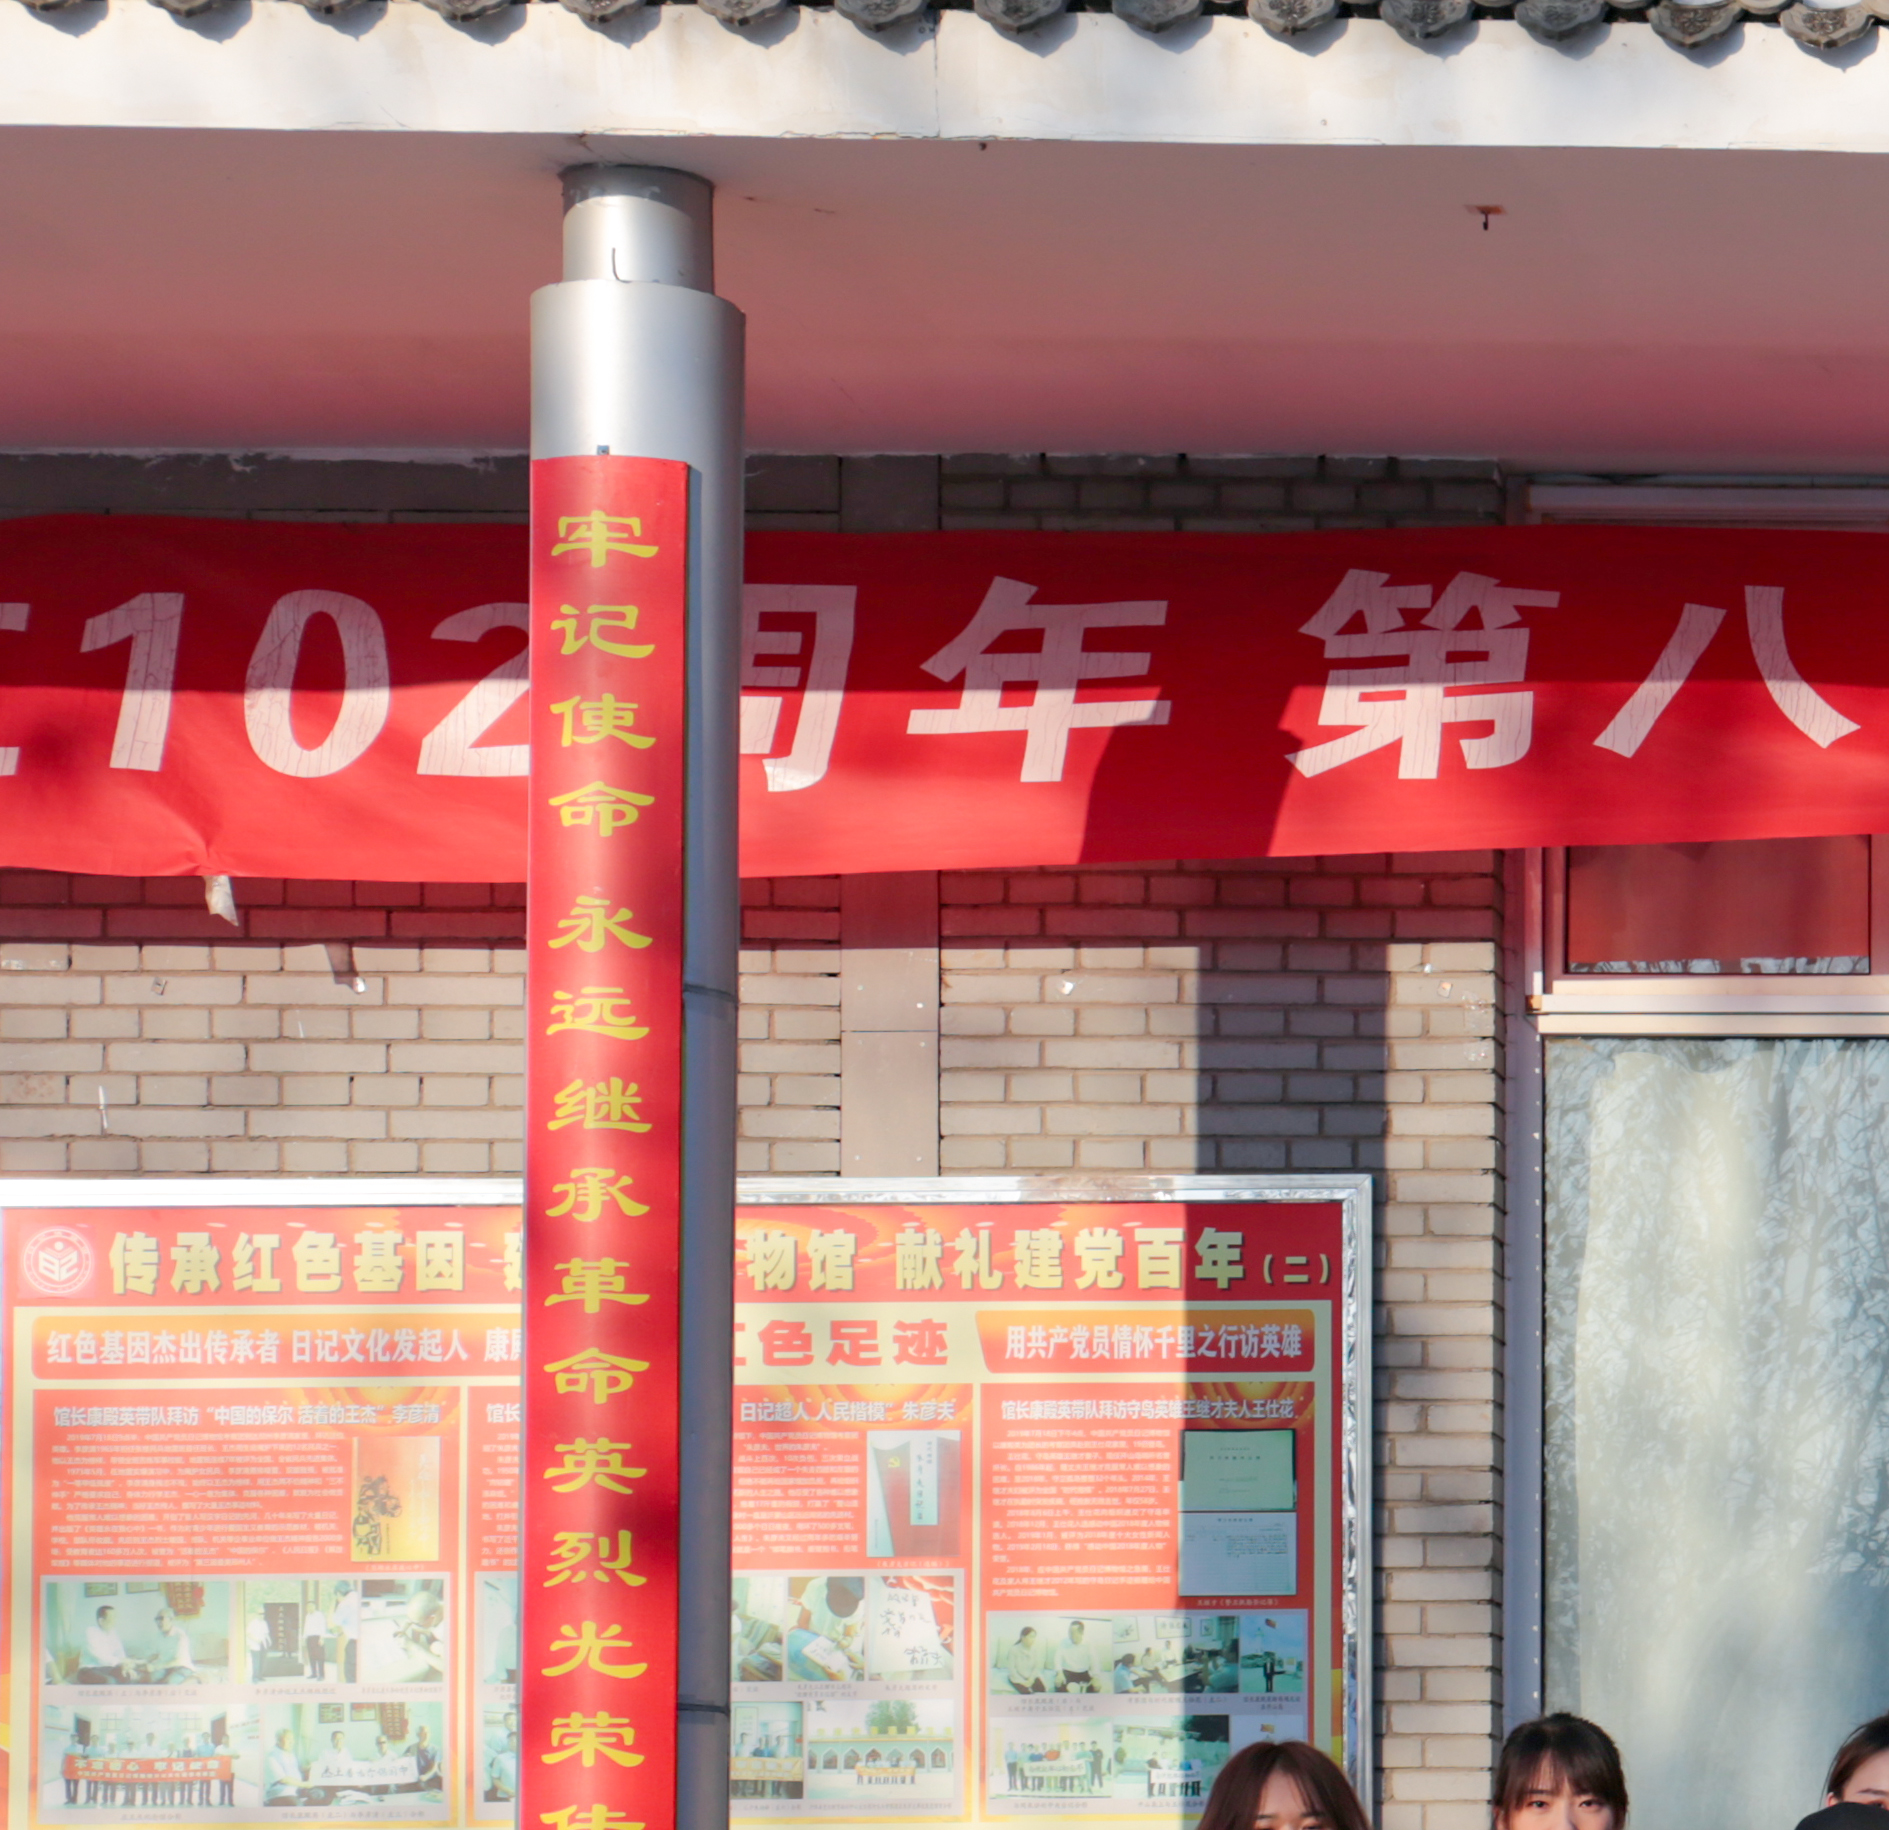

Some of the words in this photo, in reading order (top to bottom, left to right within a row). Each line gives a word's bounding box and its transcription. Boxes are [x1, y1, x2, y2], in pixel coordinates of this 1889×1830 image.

[548, 510, 660, 837] 牢记使命
[109, 1230, 467, 1296] 传承红色基因
[46, 1328, 280, 1366] 红色基因杰出传承者
[291, 1327, 469, 1364] 日记文化发起人
[734, 1319, 949, 1368] 色足迹
[1005, 1322, 1302, 1362] 用共产党员情怀千里之行访英雄
